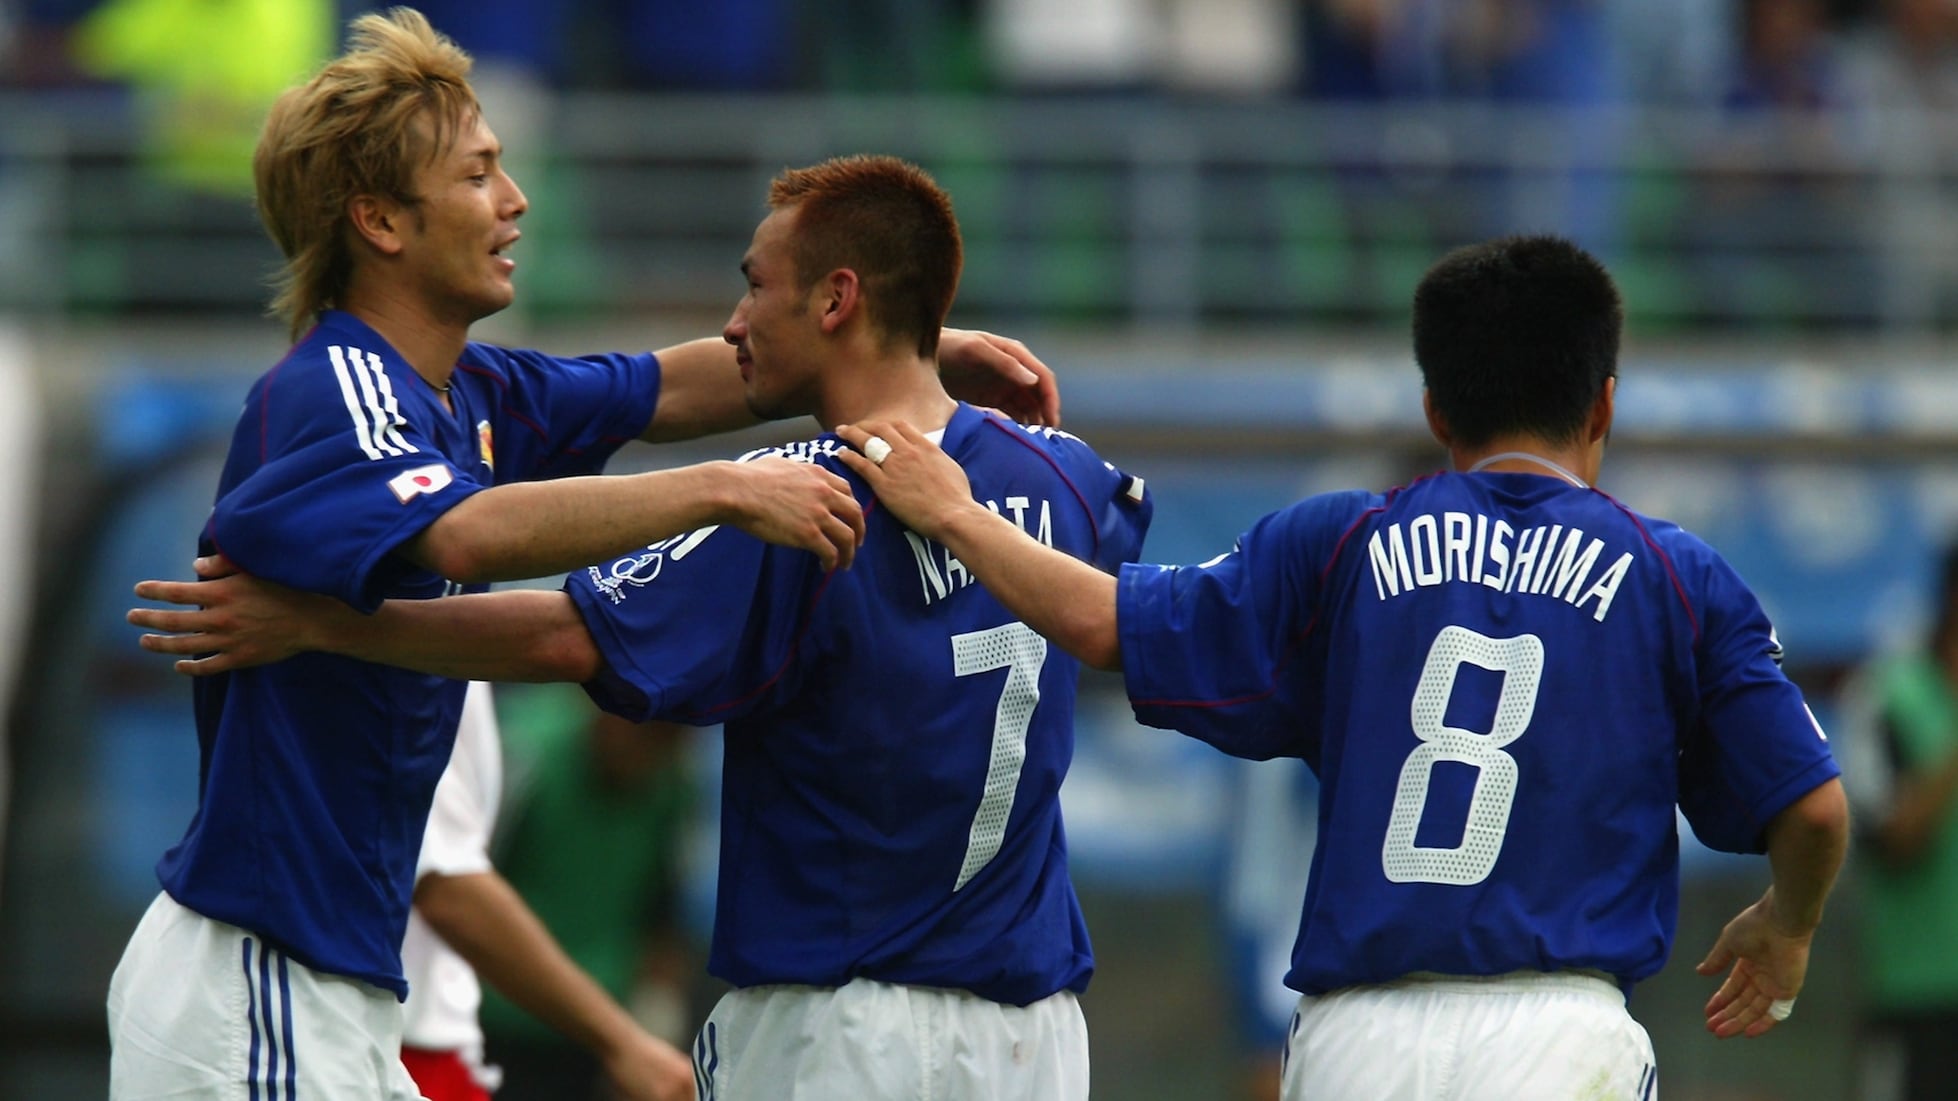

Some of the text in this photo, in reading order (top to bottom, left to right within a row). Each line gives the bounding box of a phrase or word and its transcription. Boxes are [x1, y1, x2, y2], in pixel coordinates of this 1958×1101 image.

[903, 496, 1053, 605] NATA
[1368, 511, 1634, 623] MORISHIMA
[951, 622, 1048, 892] 7
[1382, 626, 1544, 886] 8
